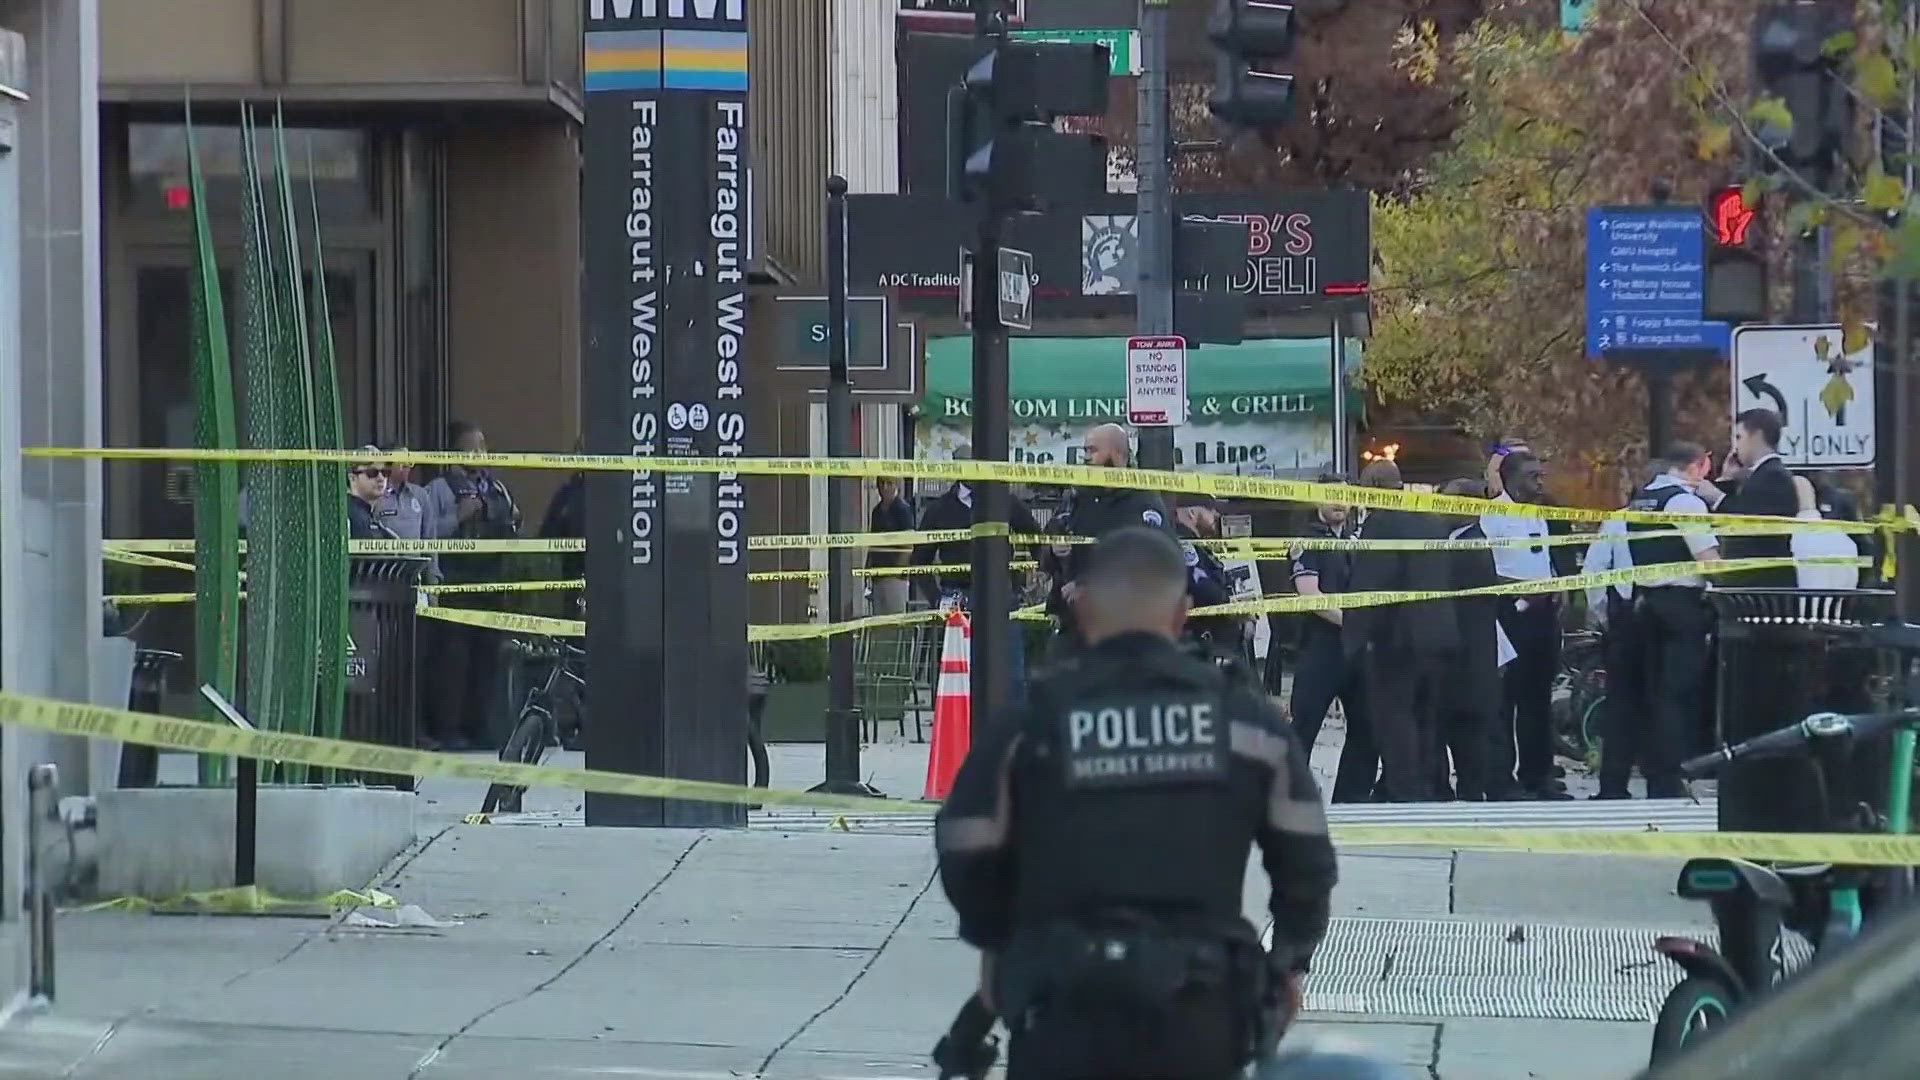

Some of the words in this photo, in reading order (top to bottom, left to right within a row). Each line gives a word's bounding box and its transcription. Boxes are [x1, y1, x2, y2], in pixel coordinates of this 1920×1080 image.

[626, 101, 656, 283] Farragut
[710, 102, 743, 283] Farragut
[879, 273, 888, 286] A
[890, 273, 909, 286] DC
[911, 272, 960, 286] Traditio
[632, 291, 656, 399] West
[717, 293, 744, 399] West
[1149, 352, 1162, 361] NO
[1136, 364, 1177, 373] STANDING
[1145, 375, 1178, 384] PARKING
[1137, 387, 1177, 396] ANYTIME
[1202, 396, 1222, 416] &
[1231, 394, 1315, 415] GRILL
[1195, 441, 1268, 464] Line
[1812, 434, 1870, 456] ONLY
[632, 412, 657, 564] Station
[717, 412, 744, 564] Station
[391, 541, 410, 550] LINE
[1070, 703, 1216, 752] POLICE
